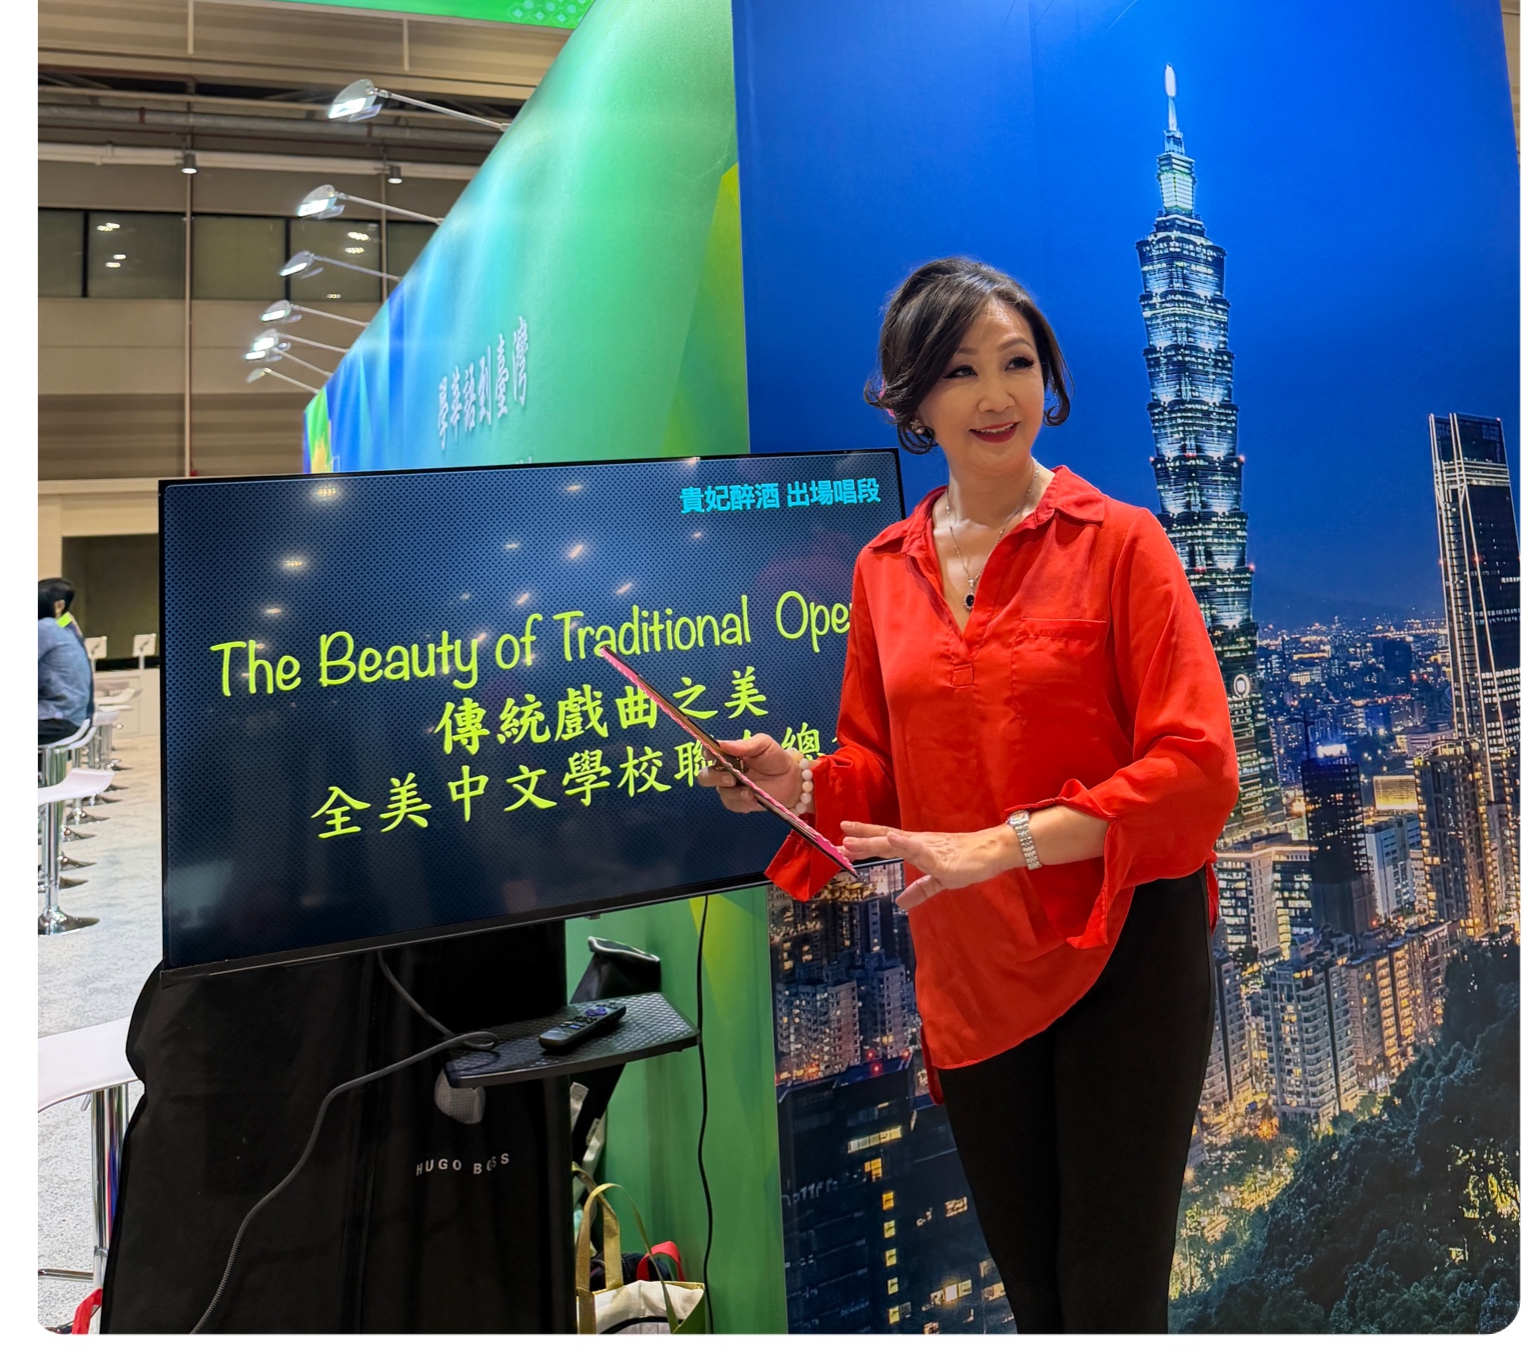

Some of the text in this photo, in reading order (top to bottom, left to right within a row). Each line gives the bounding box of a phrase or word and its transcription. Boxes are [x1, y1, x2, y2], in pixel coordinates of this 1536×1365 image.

[680, 477, 882, 515] 貴妃醉酒 出場唱段
[210, 590, 853, 697] The Beauty of Traditional Ope
[434, 665, 770, 757] 傳統戲曲之美
[309, 721, 846, 840] 全美中文學校聯總
[416, 1158, 462, 1176] HUGO
